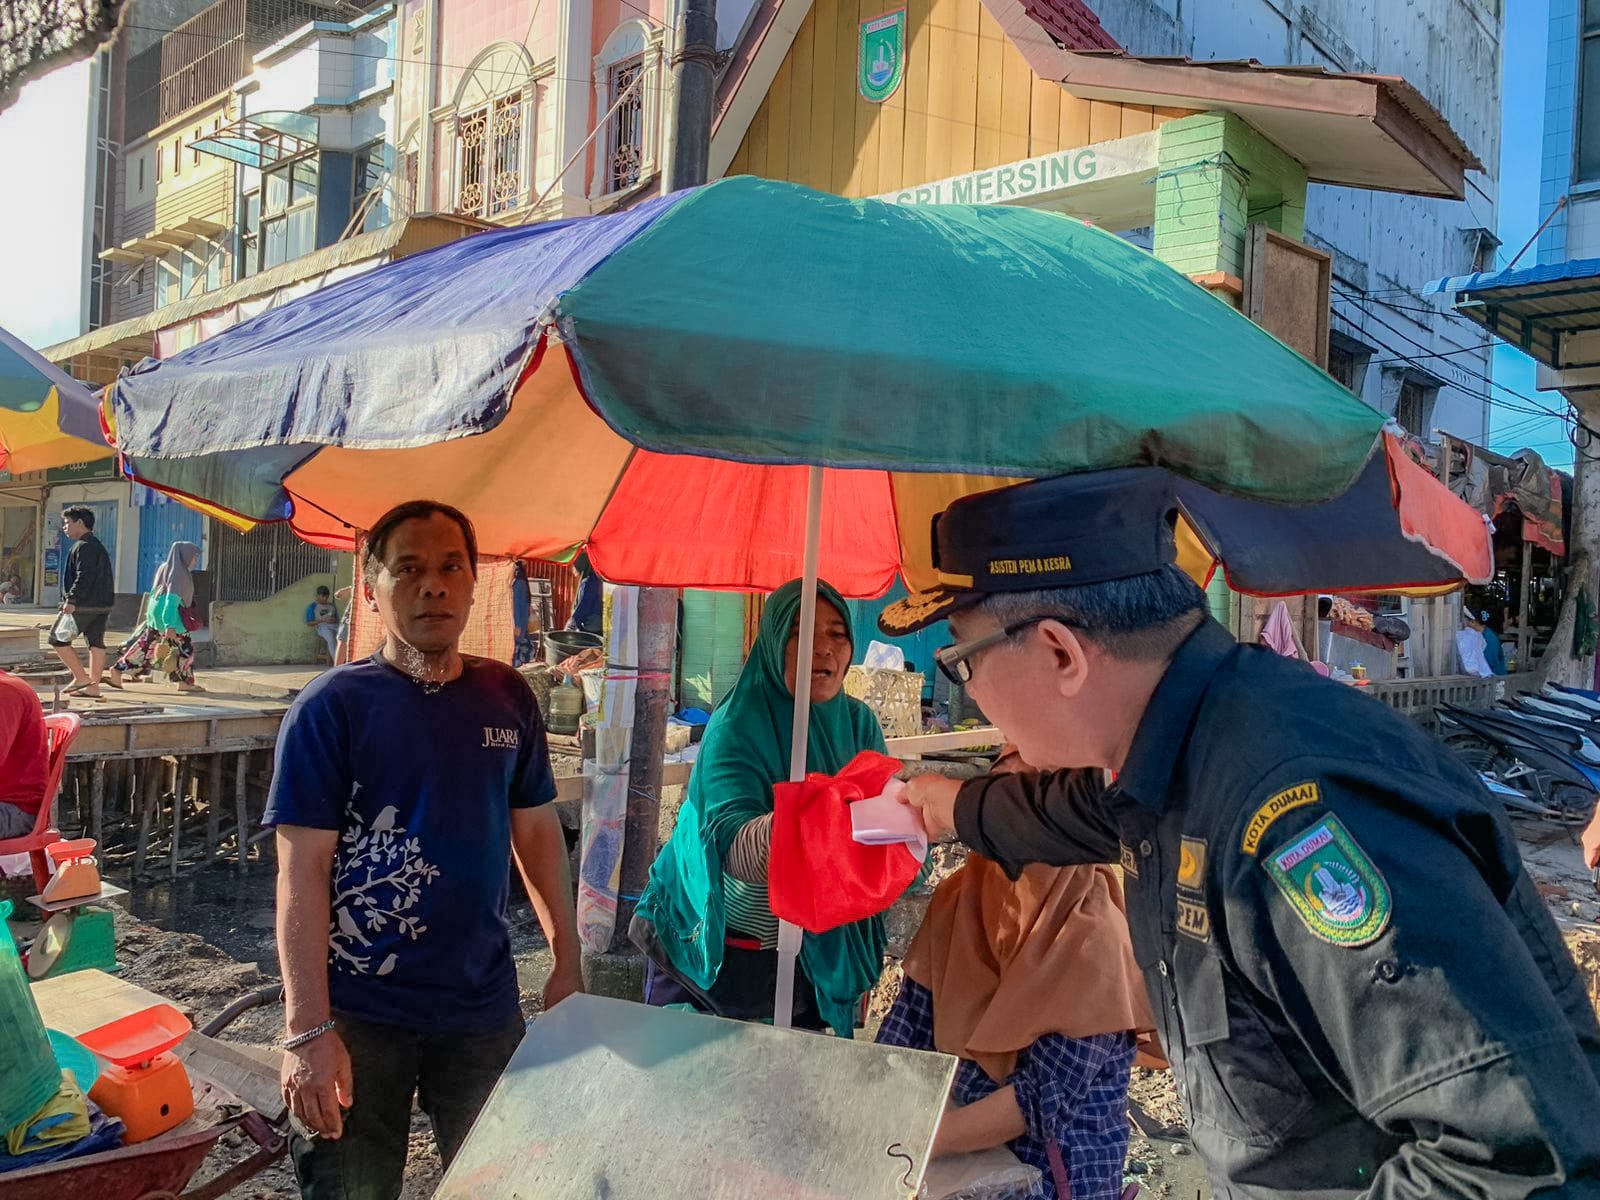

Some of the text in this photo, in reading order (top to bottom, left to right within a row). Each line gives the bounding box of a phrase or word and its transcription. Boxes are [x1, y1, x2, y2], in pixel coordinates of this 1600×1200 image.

[952, 150, 1097, 204] MERSING
[990, 560, 1017, 574] ASISTEN
[1019, 559, 1036, 573] PEM
[1043, 556, 1071, 571] KESRA
[481, 727, 518, 747] JUARA
[1246, 786, 1313, 848] KOTA DUMAI
[1281, 832, 1329, 869] KOTA DUMAI
